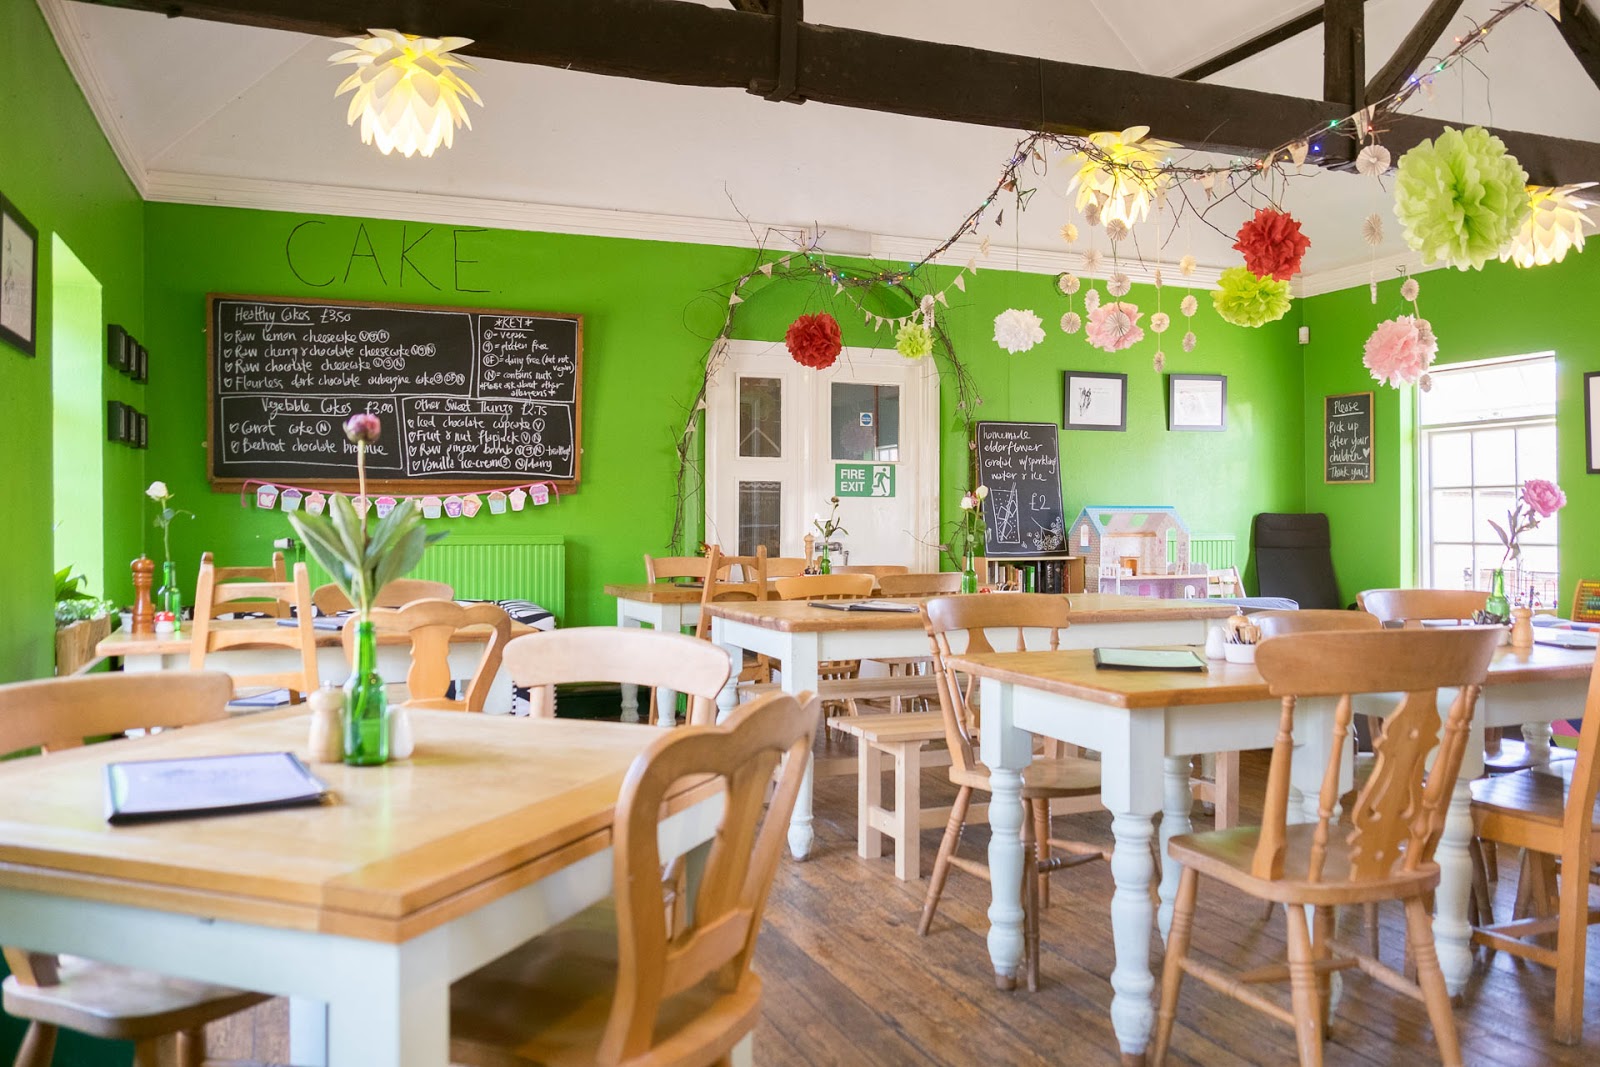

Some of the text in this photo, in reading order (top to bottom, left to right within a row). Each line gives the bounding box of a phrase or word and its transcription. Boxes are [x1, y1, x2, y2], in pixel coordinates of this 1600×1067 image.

[286, 220, 492, 293] CAKE
[235, 306, 275, 331] Healthy
[281, 307, 310, 322] Cakes
[235, 330, 255, 343] Raw
[262, 328, 296, 341] lemon
[303, 329, 357, 343] cheesecake
[235, 345, 257, 358] Raw
[264, 344, 298, 361] cherry
[309, 344, 354, 358] chocolate
[360, 344, 410, 357] cheesecake
[501, 342, 527, 357] gluten
[532, 340, 549, 353] free
[235, 359, 260, 374] Raw
[265, 359, 313, 373] chocolate
[321, 357, 371, 371] cheesecake
[504, 355, 525, 372] dairy
[526, 355, 541, 365] free
[557, 355, 569, 364] not
[236, 375, 283, 391] Flourless
[291, 374, 314, 388] dark
[319, 372, 362, 387] chocolate
[368, 373, 411, 392] aubergine
[415, 372, 435, 386] cake
[503, 369, 532, 380] contains
[535, 371, 552, 380] nuts
[504, 381, 516, 390] ask
[516, 380, 538, 389] about
[541, 381, 565, 389] other
[262, 398, 312, 420] Vegetable
[320, 399, 351, 415] Cakes
[415, 398, 547, 421] Other Sweet Things £2.75
[1334, 400, 1360, 414] Please
[241, 420, 276, 435] Carrot
[289, 421, 315, 436] cake
[417, 415, 436, 427] Iced
[443, 415, 485, 428] chocolate
[493, 417, 531, 436] cupcake
[983, 426, 1031, 440] homemade
[1329, 421, 1359, 438] Pick up
[243, 437, 388, 456] Beetroot chocolate bronie
[417, 430, 442, 443] Fruit
[455, 430, 472, 442] nut
[478, 430, 520, 449] flapjack
[984, 440, 1043, 455] elderflower
[1329, 435, 1369, 453] after your
[420, 443, 441, 456] Raw
[447, 444, 479, 461] ginger
[483, 443, 513, 455] bomb
[1329, 448, 1363, 463] children
[422, 456, 454, 471] Vanilla
[984, 456, 1012, 468] cordial
[840, 468, 866, 480] FIRE
[991, 470, 1017, 481] water
[1031, 473, 1047, 481] ice
[1328, 465, 1369, 480] Thank you!
[840, 481, 866, 492] EXIT
[1029, 493, 1051, 511] £2
